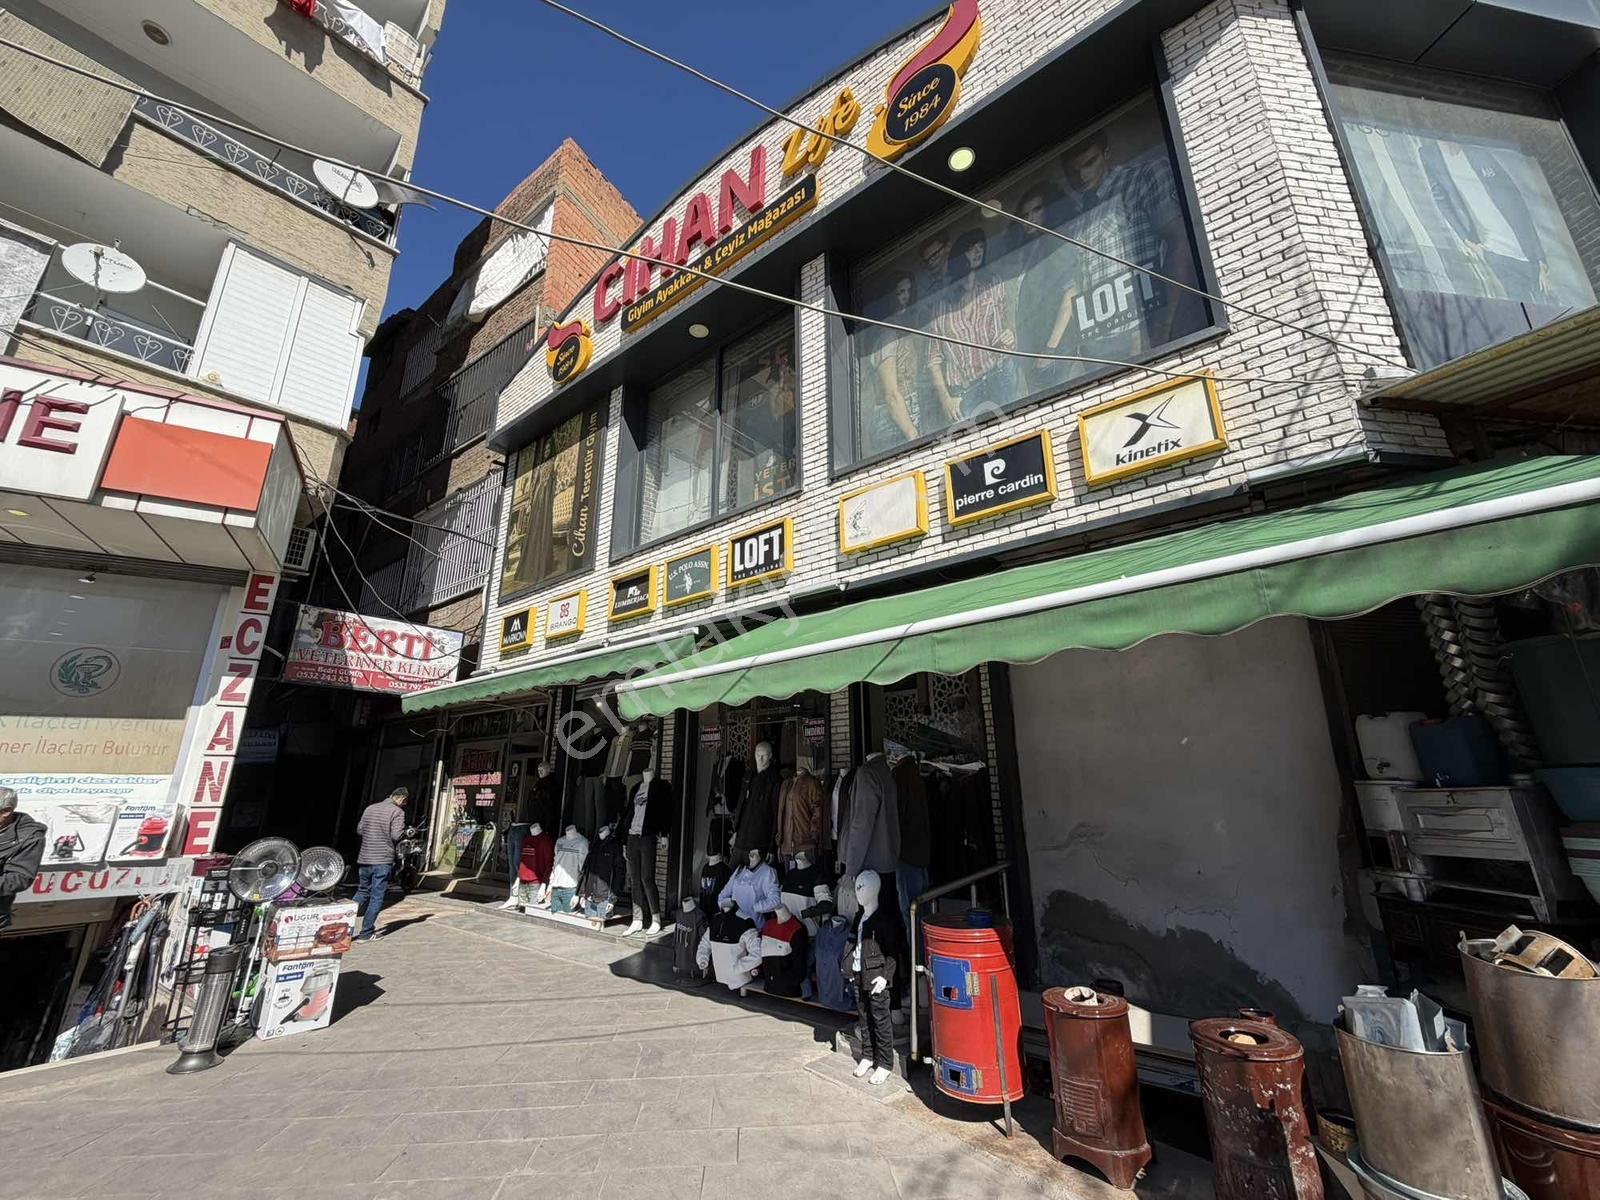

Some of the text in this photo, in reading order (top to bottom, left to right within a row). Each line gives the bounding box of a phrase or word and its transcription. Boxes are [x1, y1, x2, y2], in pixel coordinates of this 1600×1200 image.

[897, 77, 940, 118] Since
[904, 94, 942, 132] 1984
[627, 298, 655, 323] Giyim
[704, 254, 713, 268] &
[714, 234, 746, 264] Çeyiz
[747, 187, 807, 237] Mağazası
[1075, 262, 1155, 331] LOFT
[1115, 437, 1183, 467] kinetix
[955, 472, 1045, 511] pierre cardin
[572, 505, 588, 557] Cihan
[734, 528, 783, 573] LOFT
[182, 574, 275, 858] ECZANE
[34, 736, 97, 757] İlaçları
[102, 740, 170, 756] Bulunur
